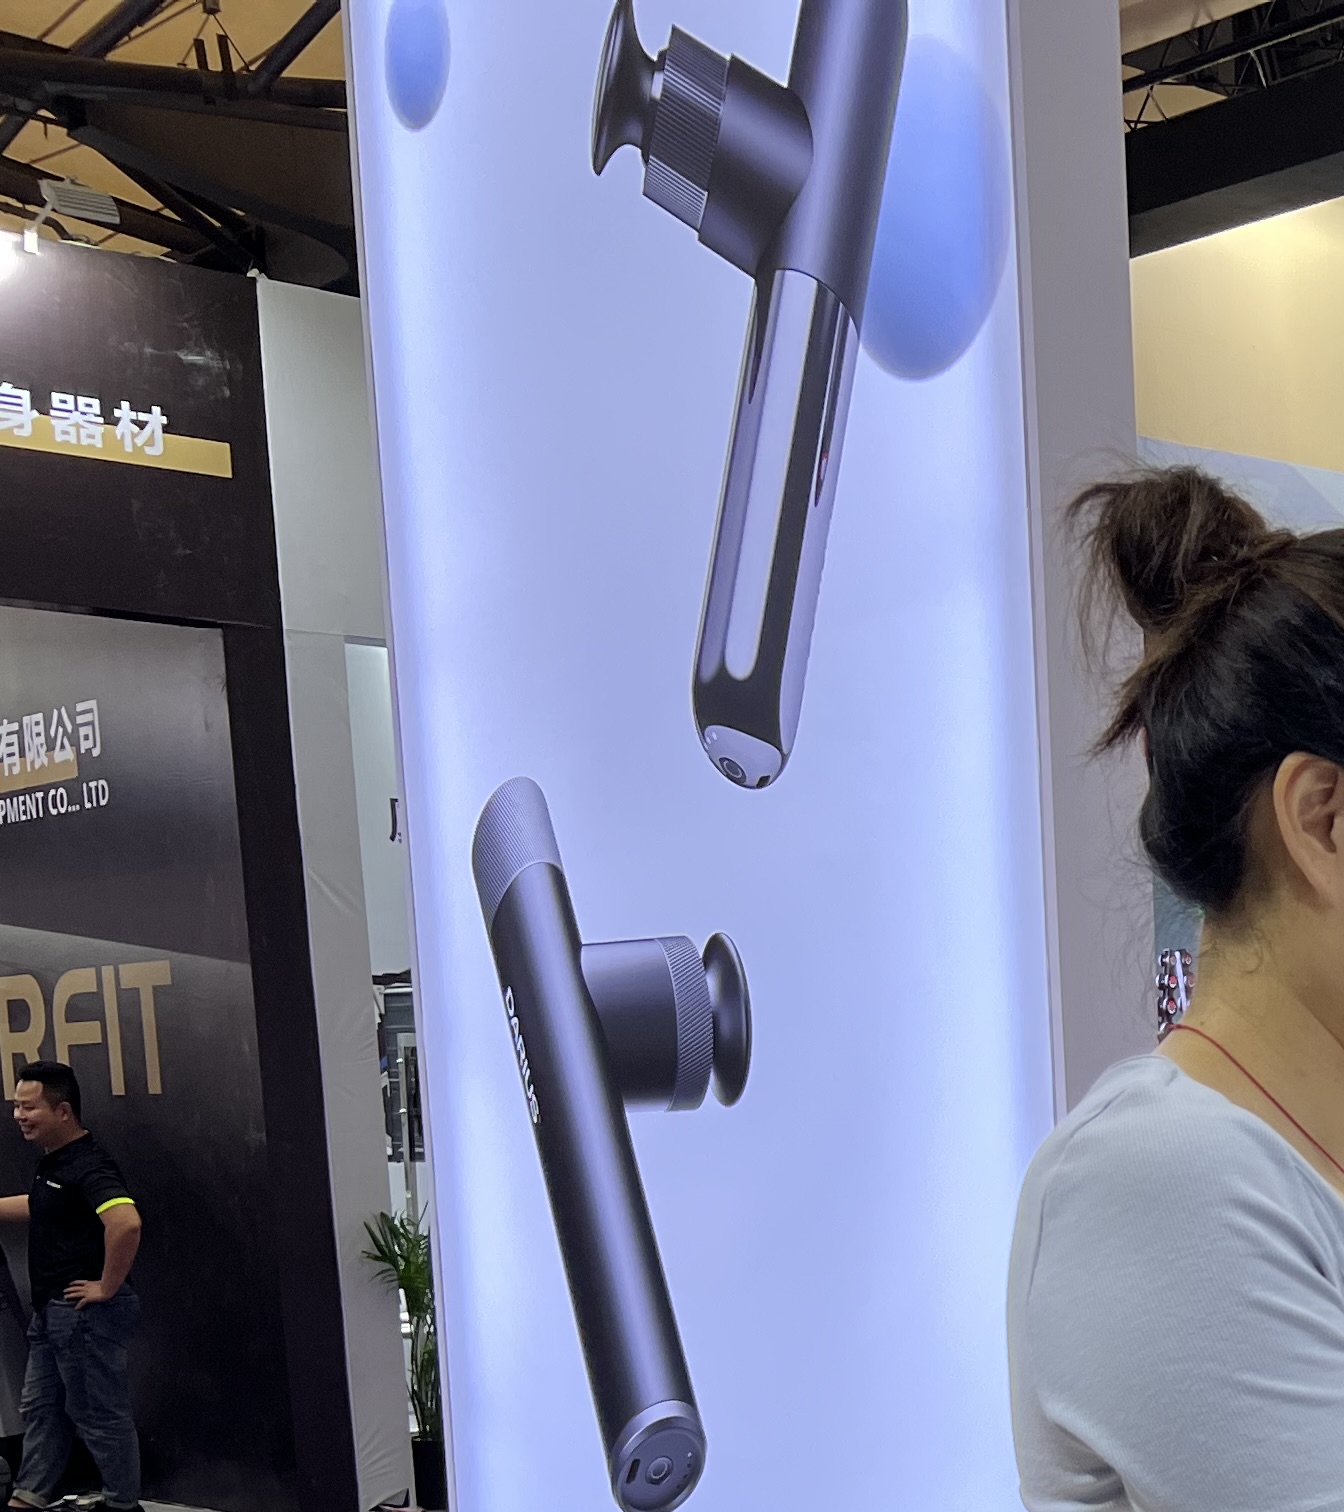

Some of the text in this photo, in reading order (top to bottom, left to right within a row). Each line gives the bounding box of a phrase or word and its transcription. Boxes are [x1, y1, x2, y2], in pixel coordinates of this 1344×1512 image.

[0, 699, 101, 776] 有限公司
[82, 779, 109, 808] LTD
[505, 986, 541, 1124] DARIUS
